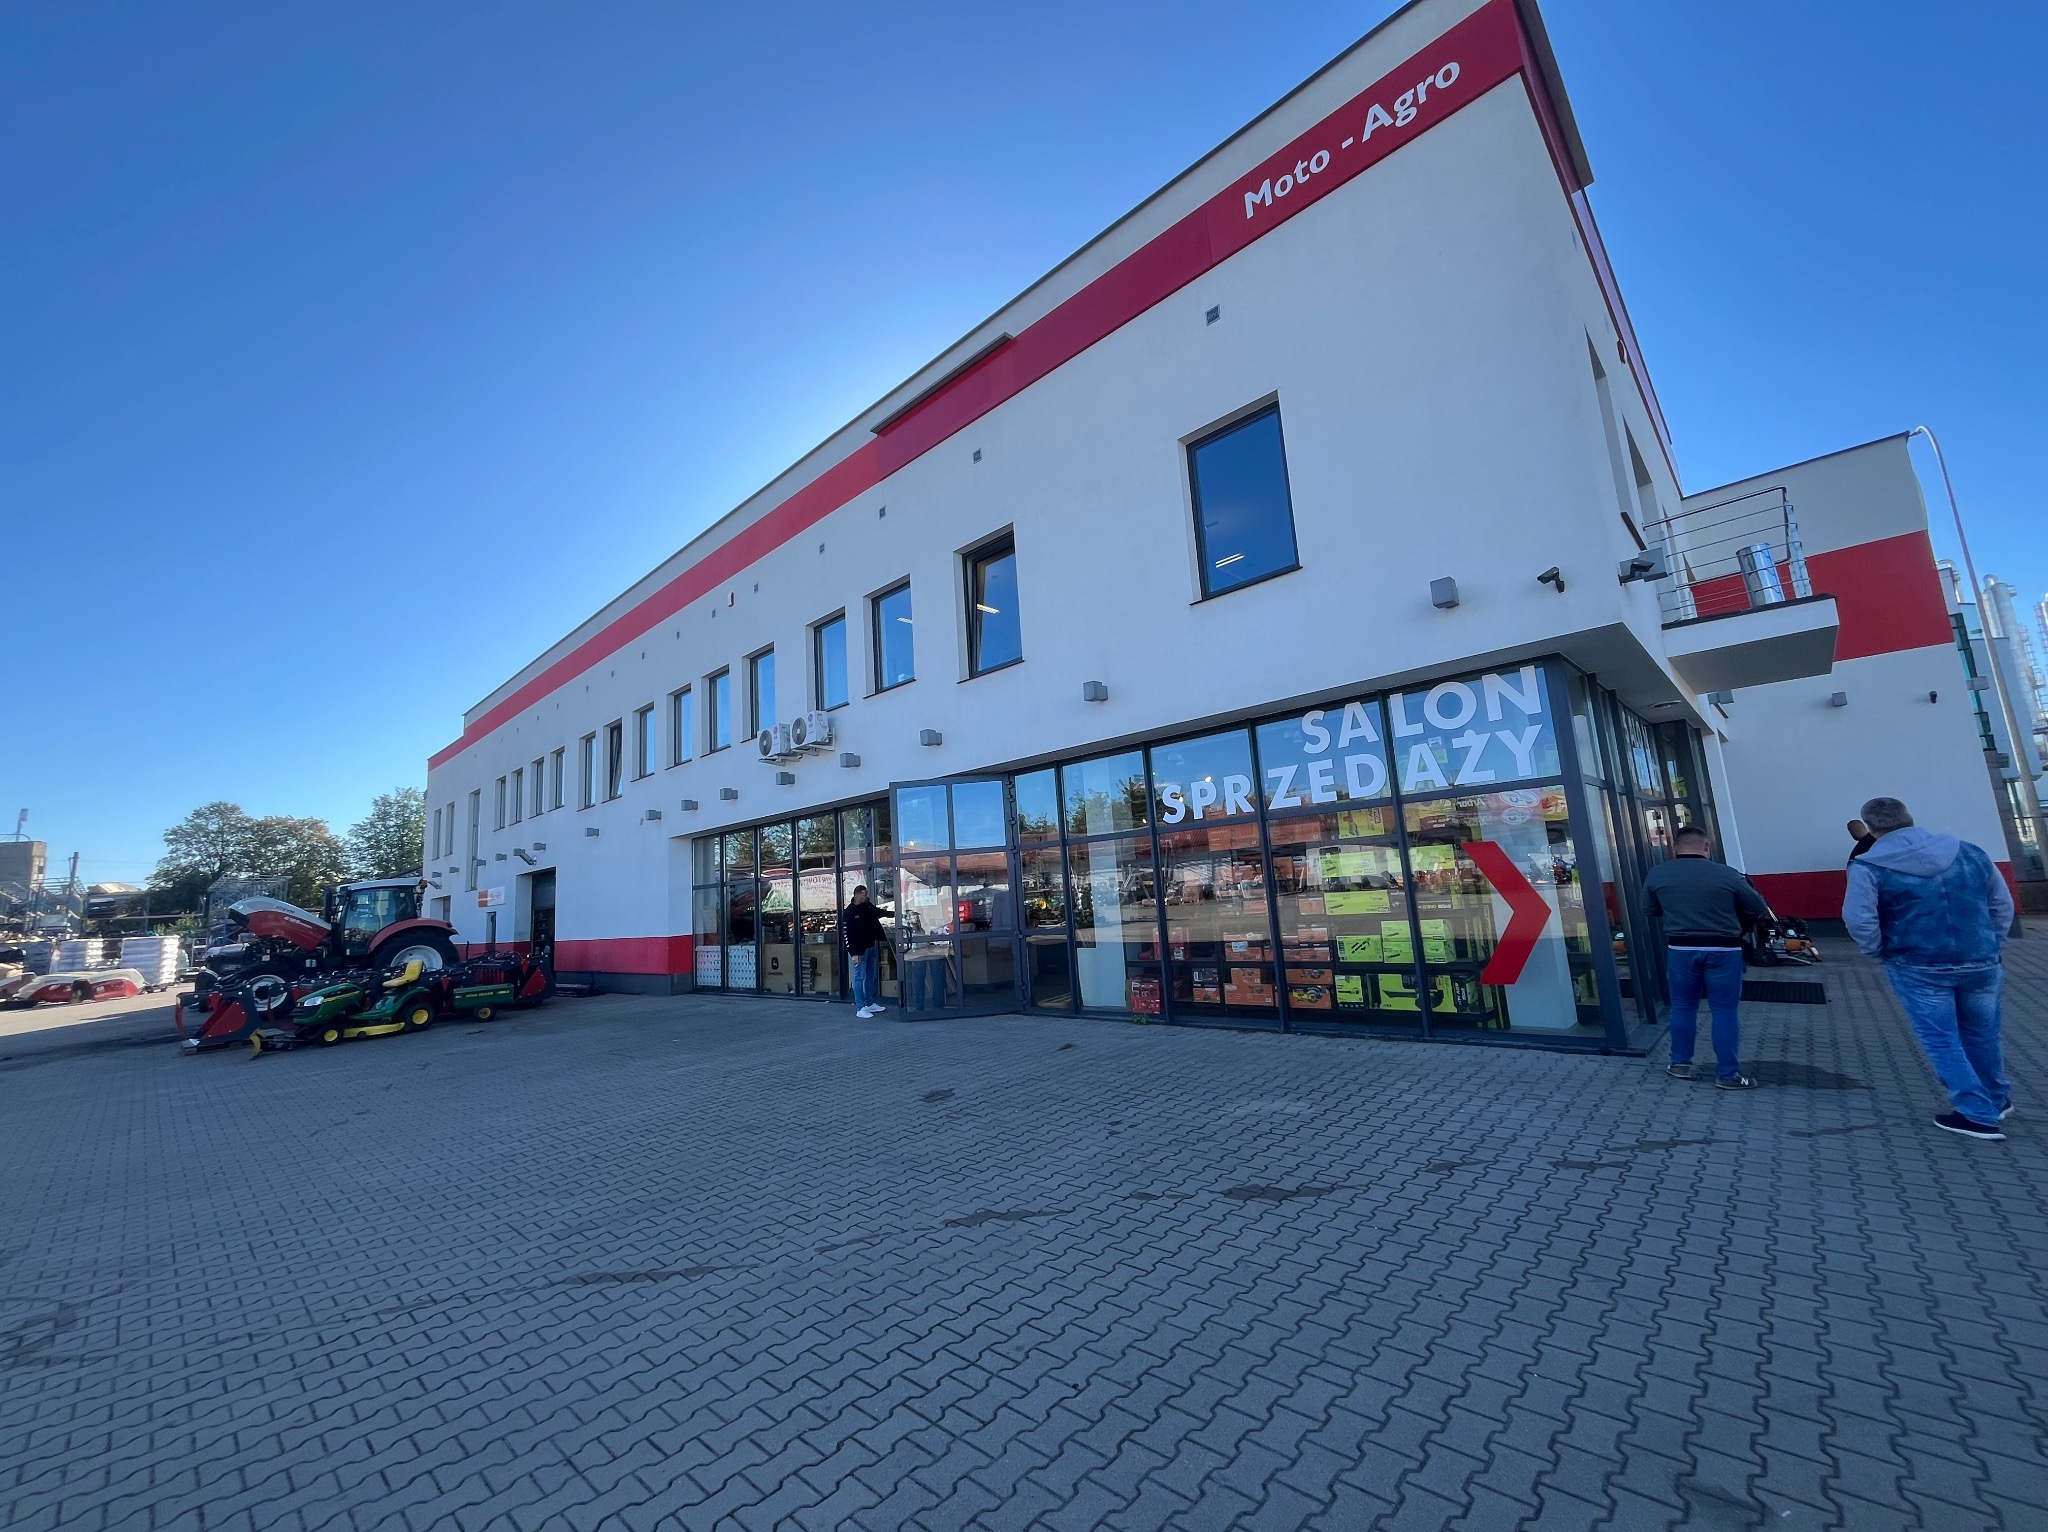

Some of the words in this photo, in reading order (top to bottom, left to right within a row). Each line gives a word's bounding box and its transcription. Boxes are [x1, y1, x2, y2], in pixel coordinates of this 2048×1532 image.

[1244, 150, 1330, 219] Moto
[1362, 62, 1460, 143] Agro
[1301, 665, 1542, 754] SALON
[1162, 724, 1543, 824] SPRZEDAŻY
[1740, 1077, 1749, 1086] N
